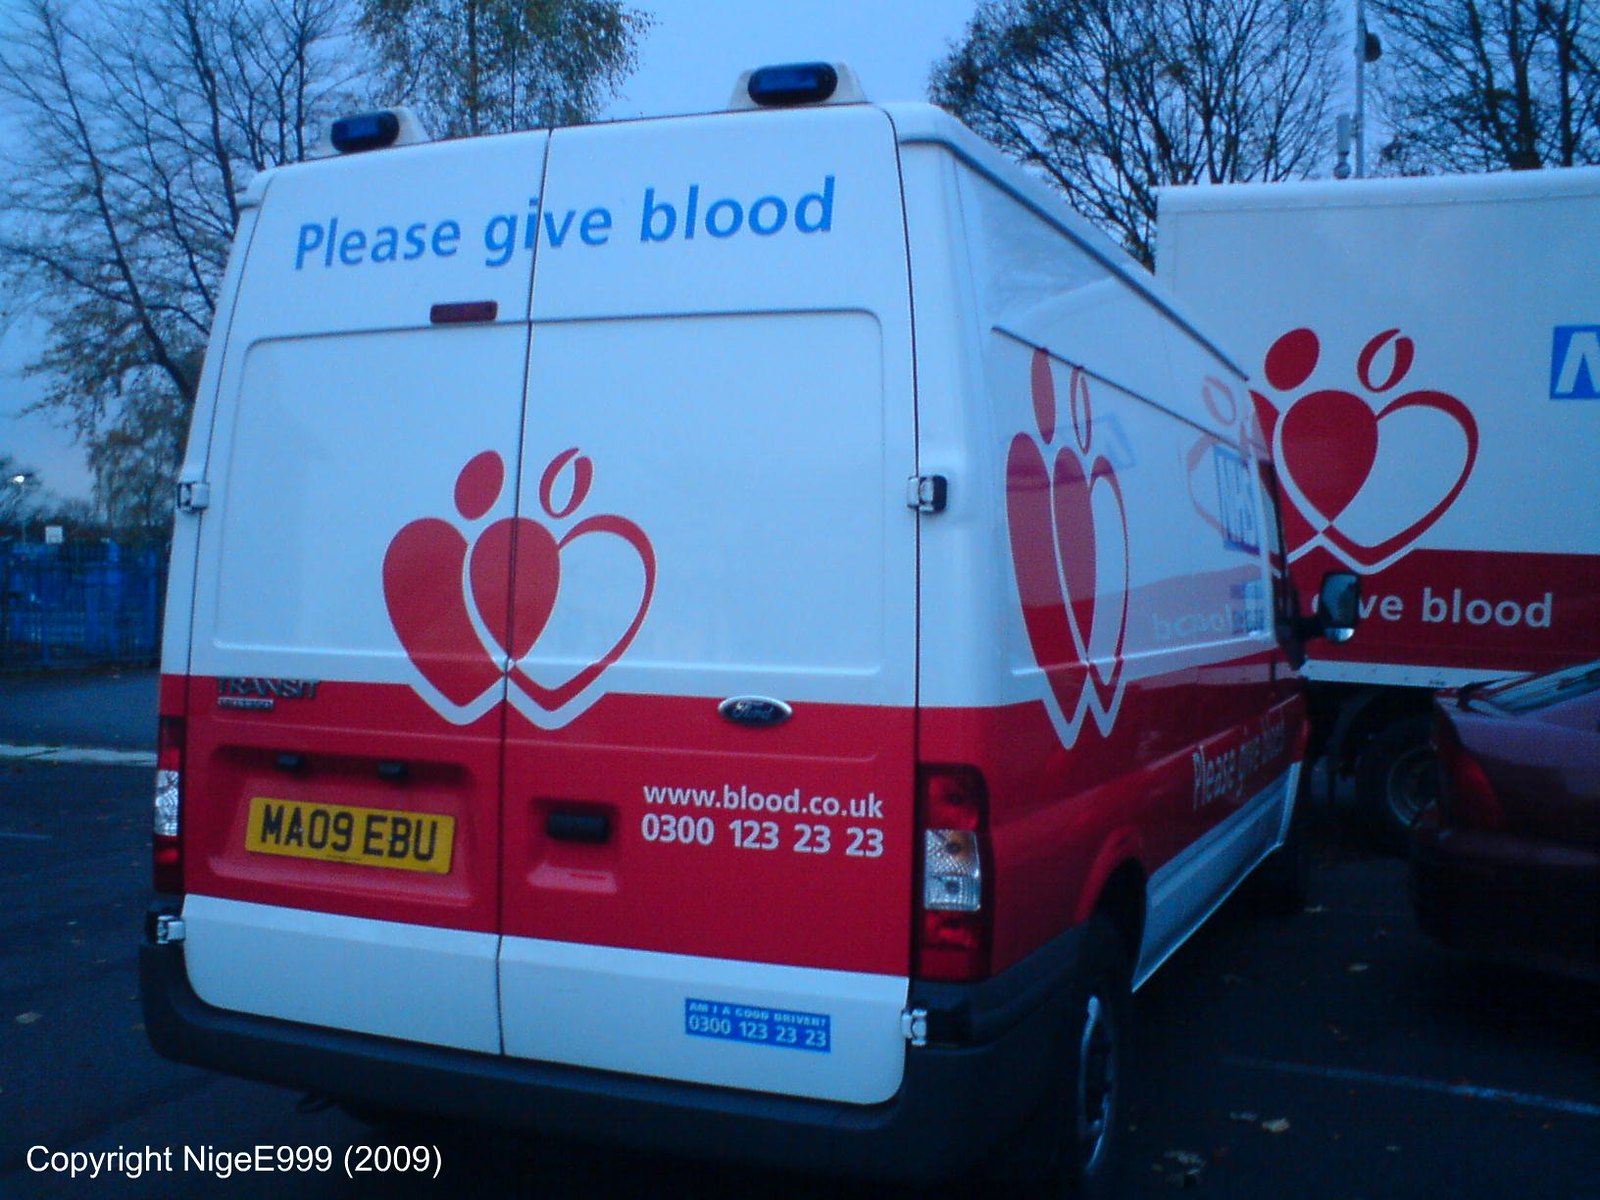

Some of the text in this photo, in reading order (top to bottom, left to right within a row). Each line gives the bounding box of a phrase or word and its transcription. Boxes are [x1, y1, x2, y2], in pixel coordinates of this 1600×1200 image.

[295, 175, 835, 269] Please give blood
[1311, 586, 1553, 628] ve blood
[643, 784, 884, 819] www.blood.co.uk
[261, 804, 438, 862] MA09 EBU
[641, 813, 885, 858] 0300 123 23 23
[688, 1014, 827, 1048] 0300 123 23 23
